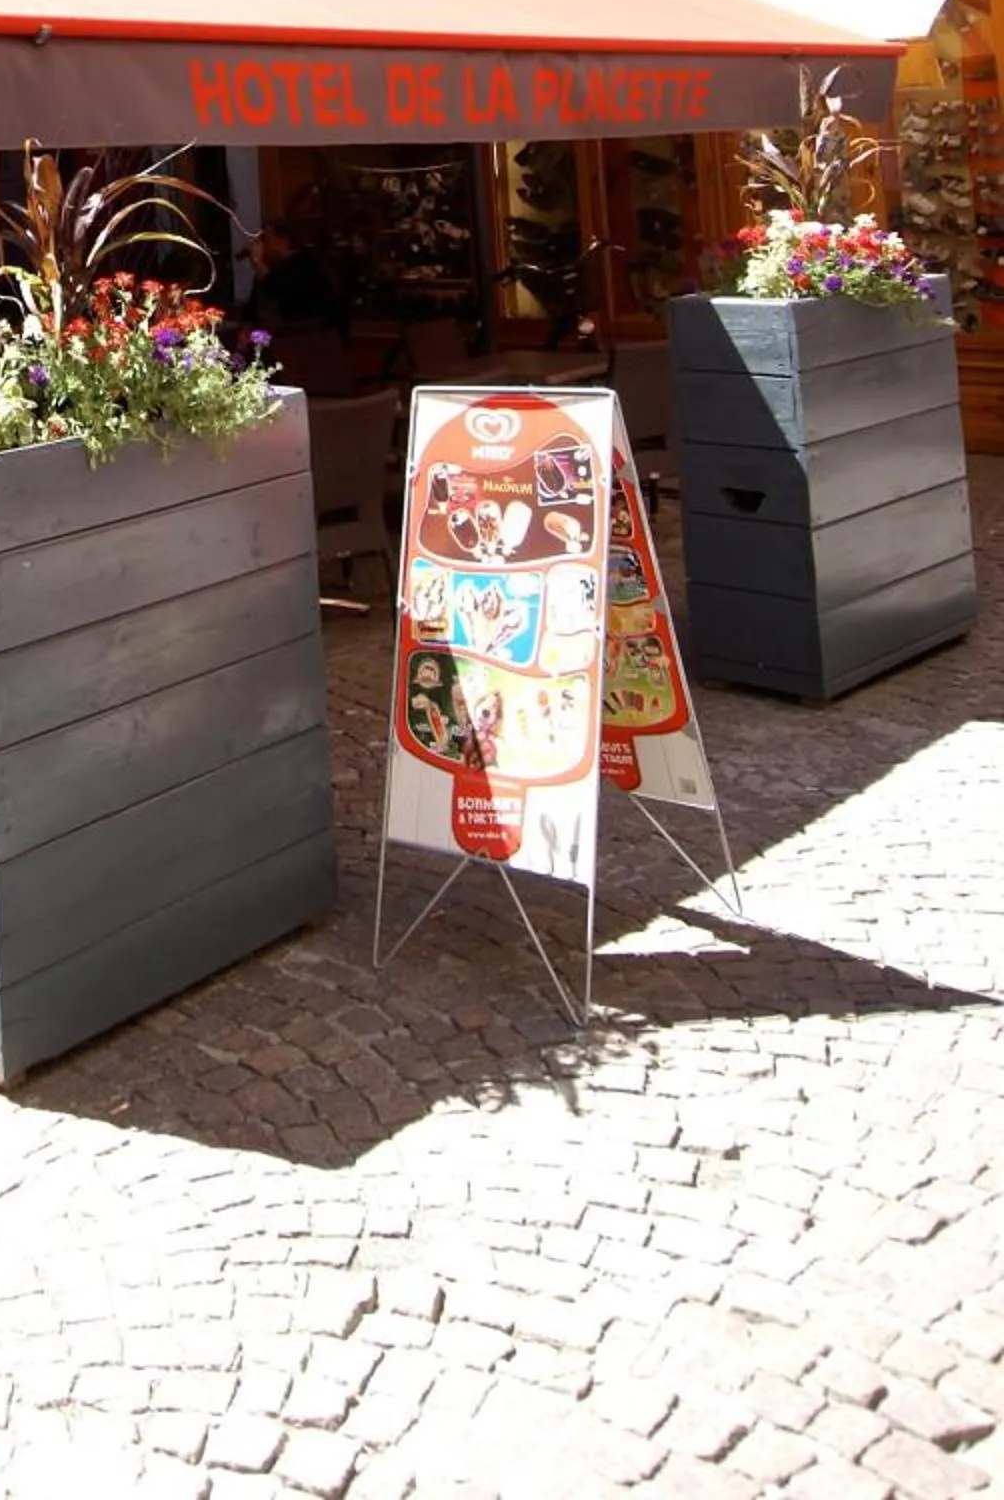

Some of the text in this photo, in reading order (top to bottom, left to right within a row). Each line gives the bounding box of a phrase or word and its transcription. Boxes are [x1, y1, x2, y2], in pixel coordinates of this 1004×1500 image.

[191, 59, 713, 128] HOTEL DE LA PLACETTE
